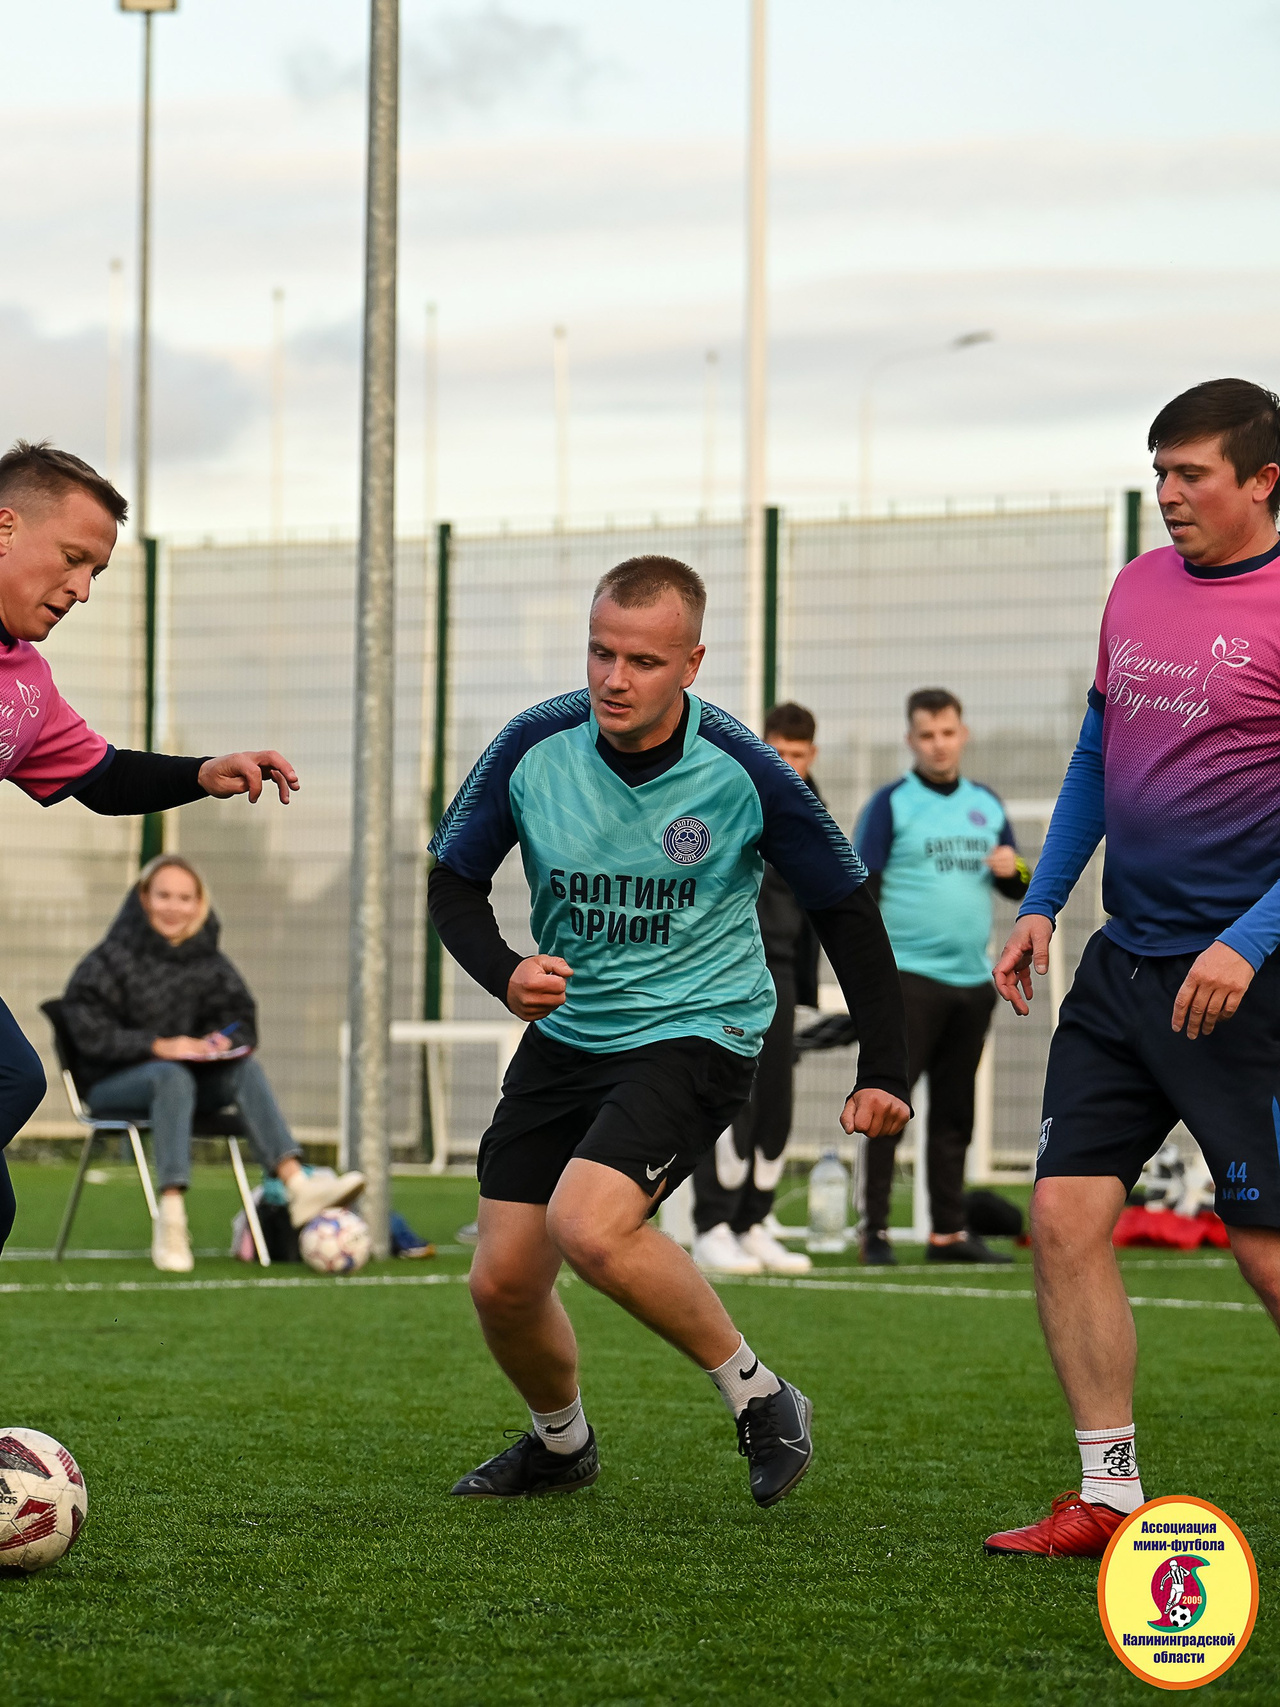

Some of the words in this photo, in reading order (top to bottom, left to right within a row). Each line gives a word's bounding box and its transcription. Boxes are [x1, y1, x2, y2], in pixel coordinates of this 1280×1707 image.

[1106, 669, 1209, 728] Бульвар
[549, 868, 697, 910] БАЛТИКА
[570, 907, 670, 944] ОРИОН
[1226, 1161, 1247, 1183] 44
